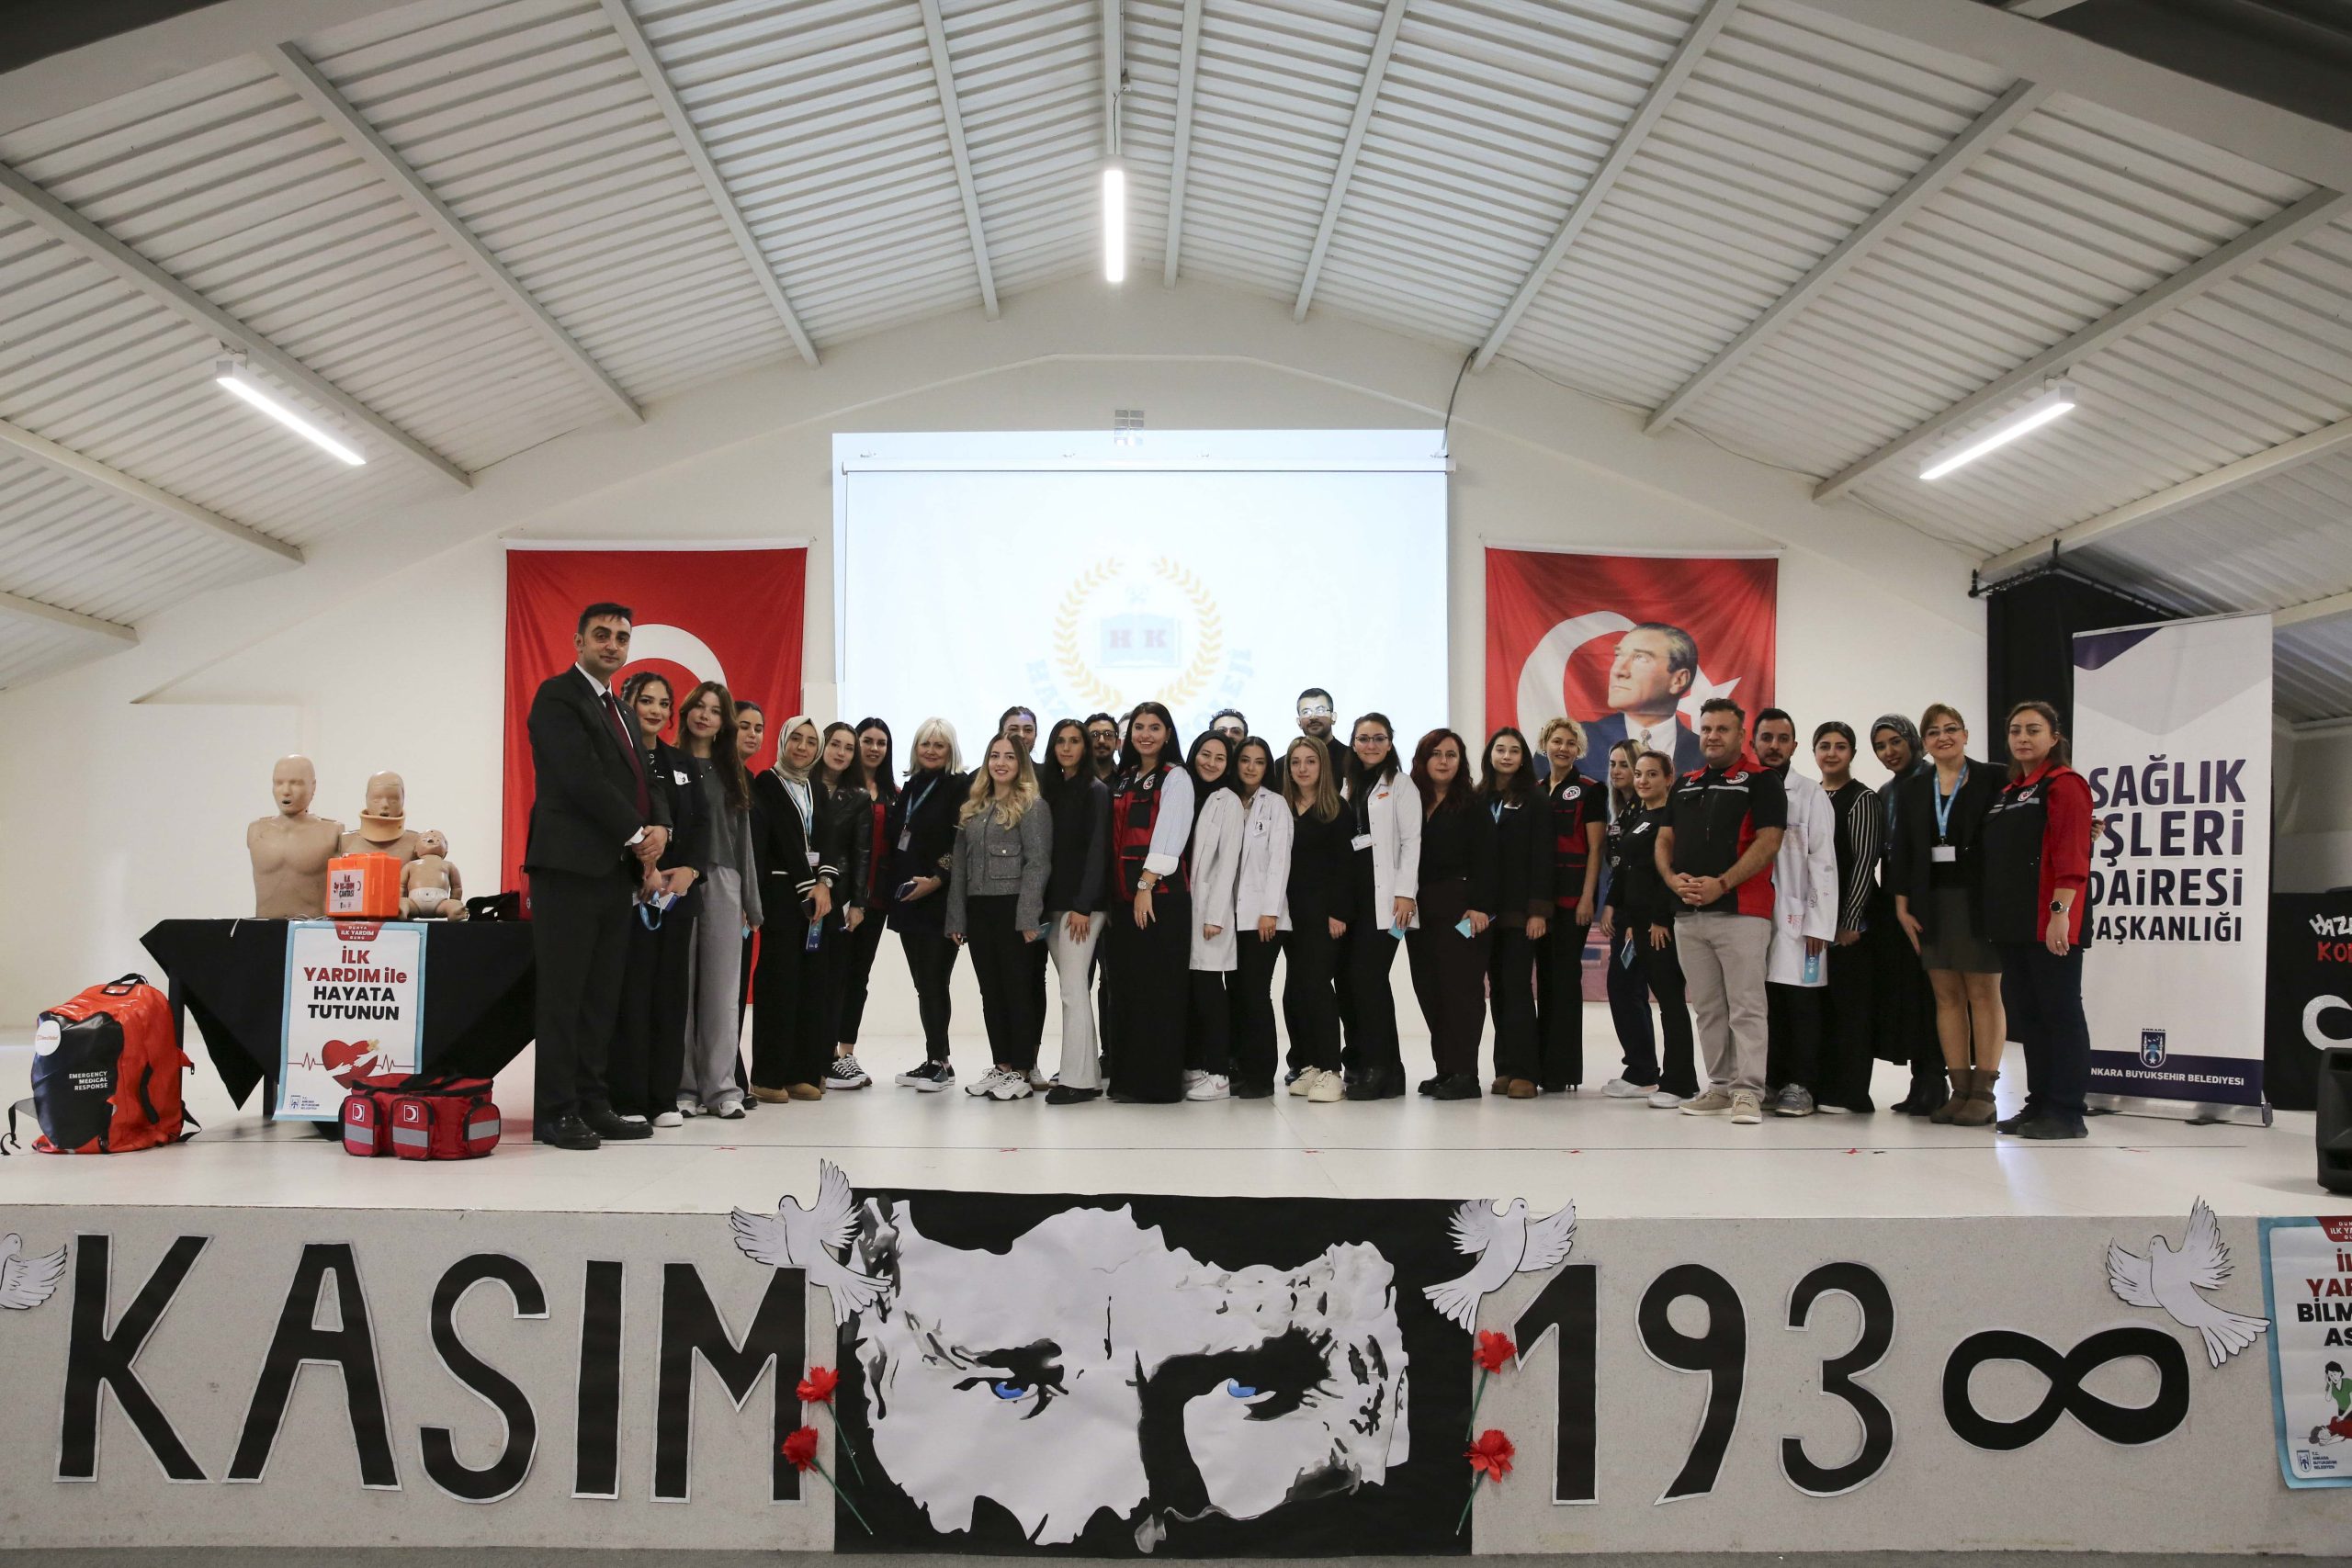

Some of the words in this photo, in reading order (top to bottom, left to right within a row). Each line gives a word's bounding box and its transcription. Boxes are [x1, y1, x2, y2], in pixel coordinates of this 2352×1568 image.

[1110, 629, 1132, 648] H
[1145, 629, 1167, 648] K
[2088, 754, 2246, 810] SAĞLIK
[2090, 809, 2244, 867] ŞLERİ
[2092, 911, 2242, 945] AŞKANLIĞI
[2309, 914, 2352, 937] HAZ
[341, 945, 370, 964] İLK
[303, 967, 380, 983] YARDIM
[384, 967, 407, 984] ile
[313, 986, 395, 1002] HAYATA
[308, 1004, 400, 1021] TUTUNUN
[2090, 1067, 2123, 1077] NKARA
[55, 1232, 809, 1504] KASIM
